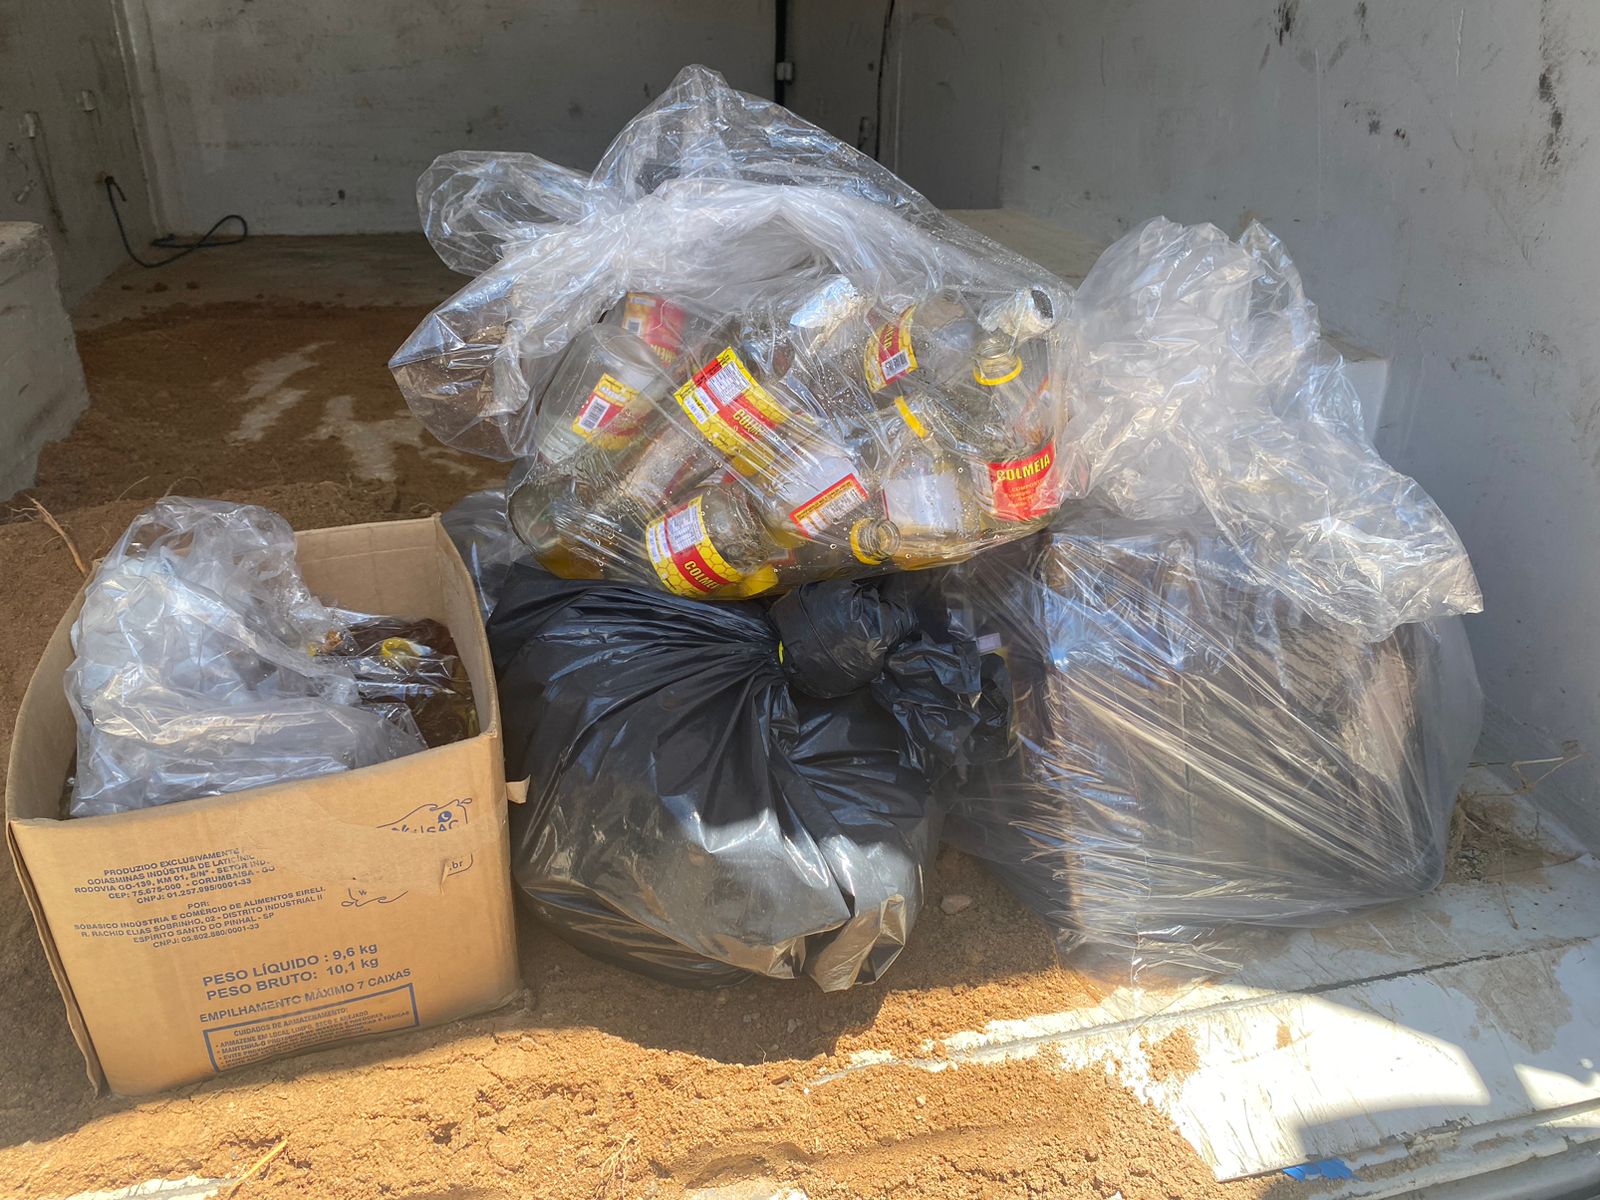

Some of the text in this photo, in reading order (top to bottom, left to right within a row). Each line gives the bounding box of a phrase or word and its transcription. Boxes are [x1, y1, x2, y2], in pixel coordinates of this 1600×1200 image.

[996, 454, 1050, 480] COLMEIA
[88, 873, 145, 885] GOIASMINAS
[146, 864, 196, 878] INDÚSTRIA
[104, 848, 240, 876] PRODUZIDO EXCLUSIVAMENTE
[74, 885, 116, 893] RODOVIA
[156, 876, 172, 884] KM
[216, 862, 248, 874] SETOR
[120, 916, 169, 928] INDÚSTRIA
[180, 906, 227, 919] COMÉRCIO
[229, 902, 241, 910] DE
[244, 892, 294, 907] ALIMENTOS
[136, 895, 165, 904] CNPJ:
[188, 901, 209, 909] POR:
[126, 928, 152, 936] ELIAS
[222, 906, 262, 918] DISTRITO
[264, 897, 316, 911] INDUSTRIAL
[133, 931, 174, 943] ESPÍRITO
[176, 926, 206, 936] SANTO
[209, 922, 222, 930] DO
[224, 917, 256, 926] PINHAL
[262, 912, 274, 920] SP
[152, 938, 180, 948] CNPJ:
[202, 970, 248, 986] PESO
[252, 955, 319, 977] LÍQUIDO
[332, 947, 355, 960] 9,6
[360, 944, 378, 954] kg
[206, 958, 379, 1000] PESO BRUTO: 10,1 kg
[200, 968, 412, 1022] EMPILHAMENTO MÁXIMO 7 CAIXAS
[234, 1024, 272, 1036] CUIDADOS
